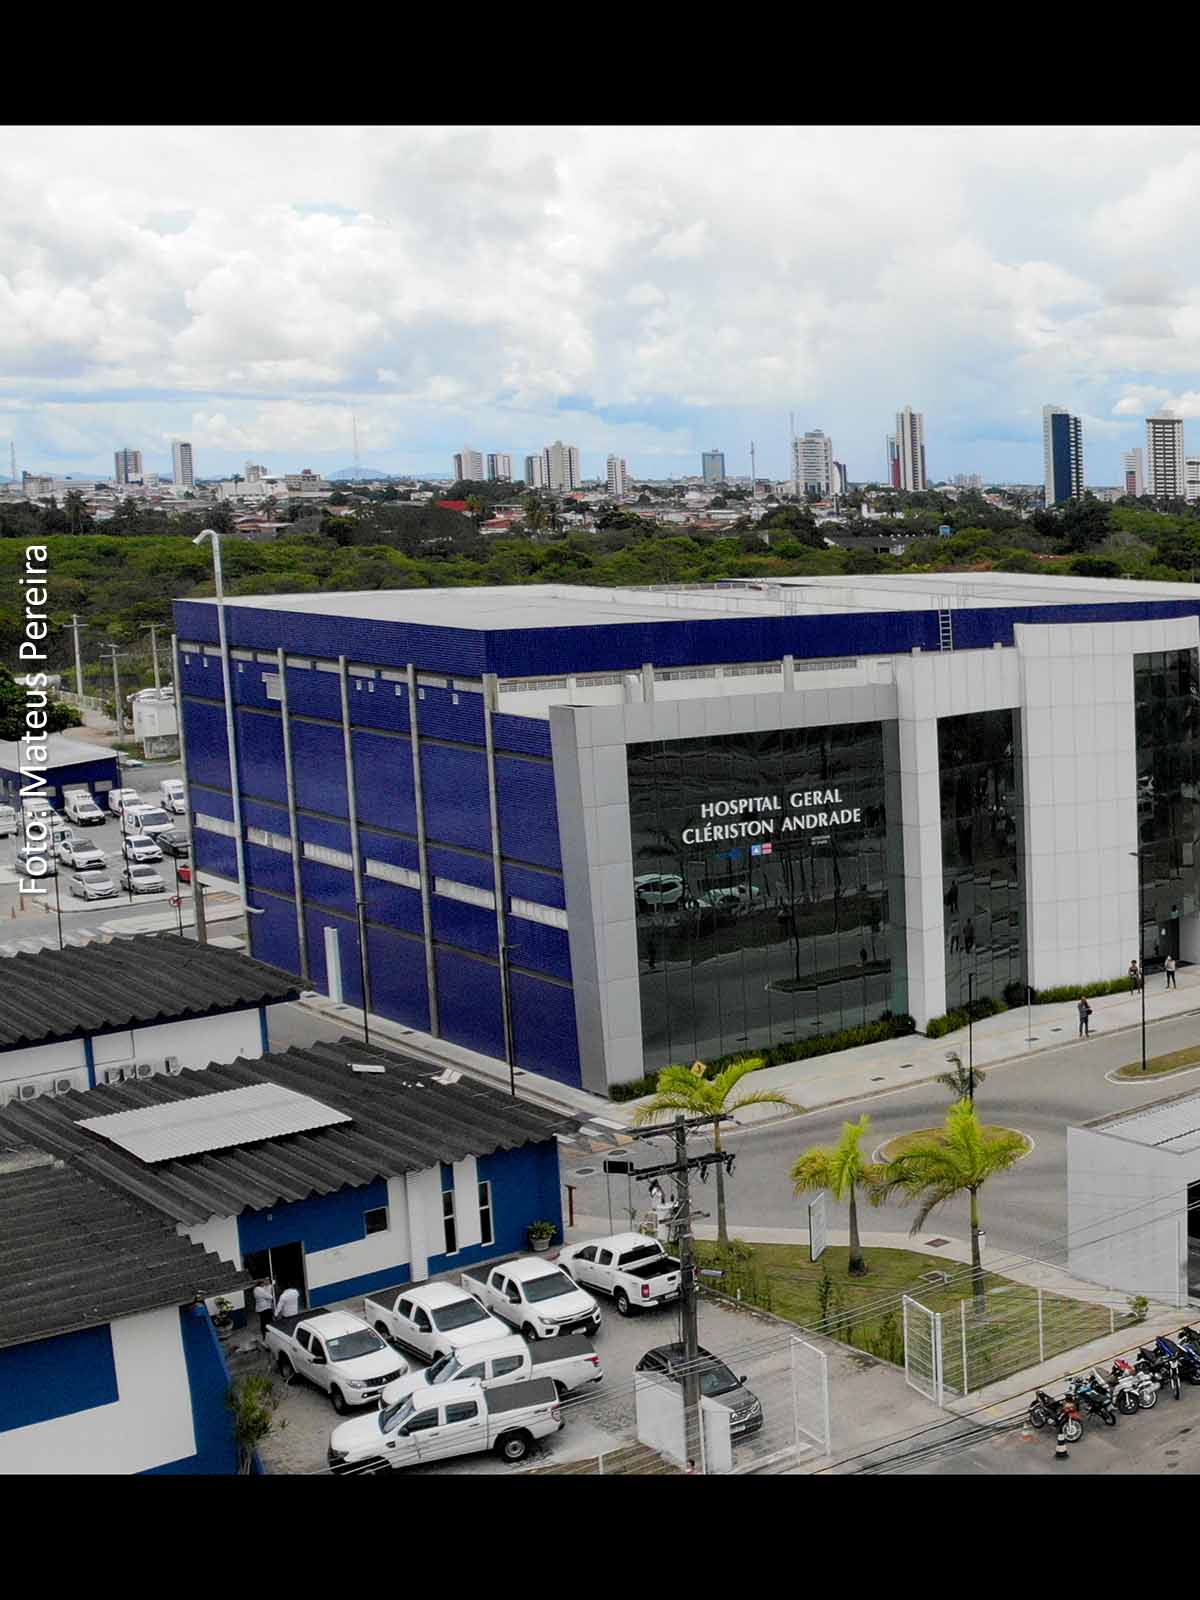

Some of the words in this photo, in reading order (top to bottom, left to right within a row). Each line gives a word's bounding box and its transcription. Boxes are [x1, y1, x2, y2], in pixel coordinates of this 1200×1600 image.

[701, 796, 782, 819] HOSPITAL
[790, 788, 843, 808] GERAL
[682, 819, 774, 845] CLÉRISTON
[782, 808, 861, 832] ANDRADE
